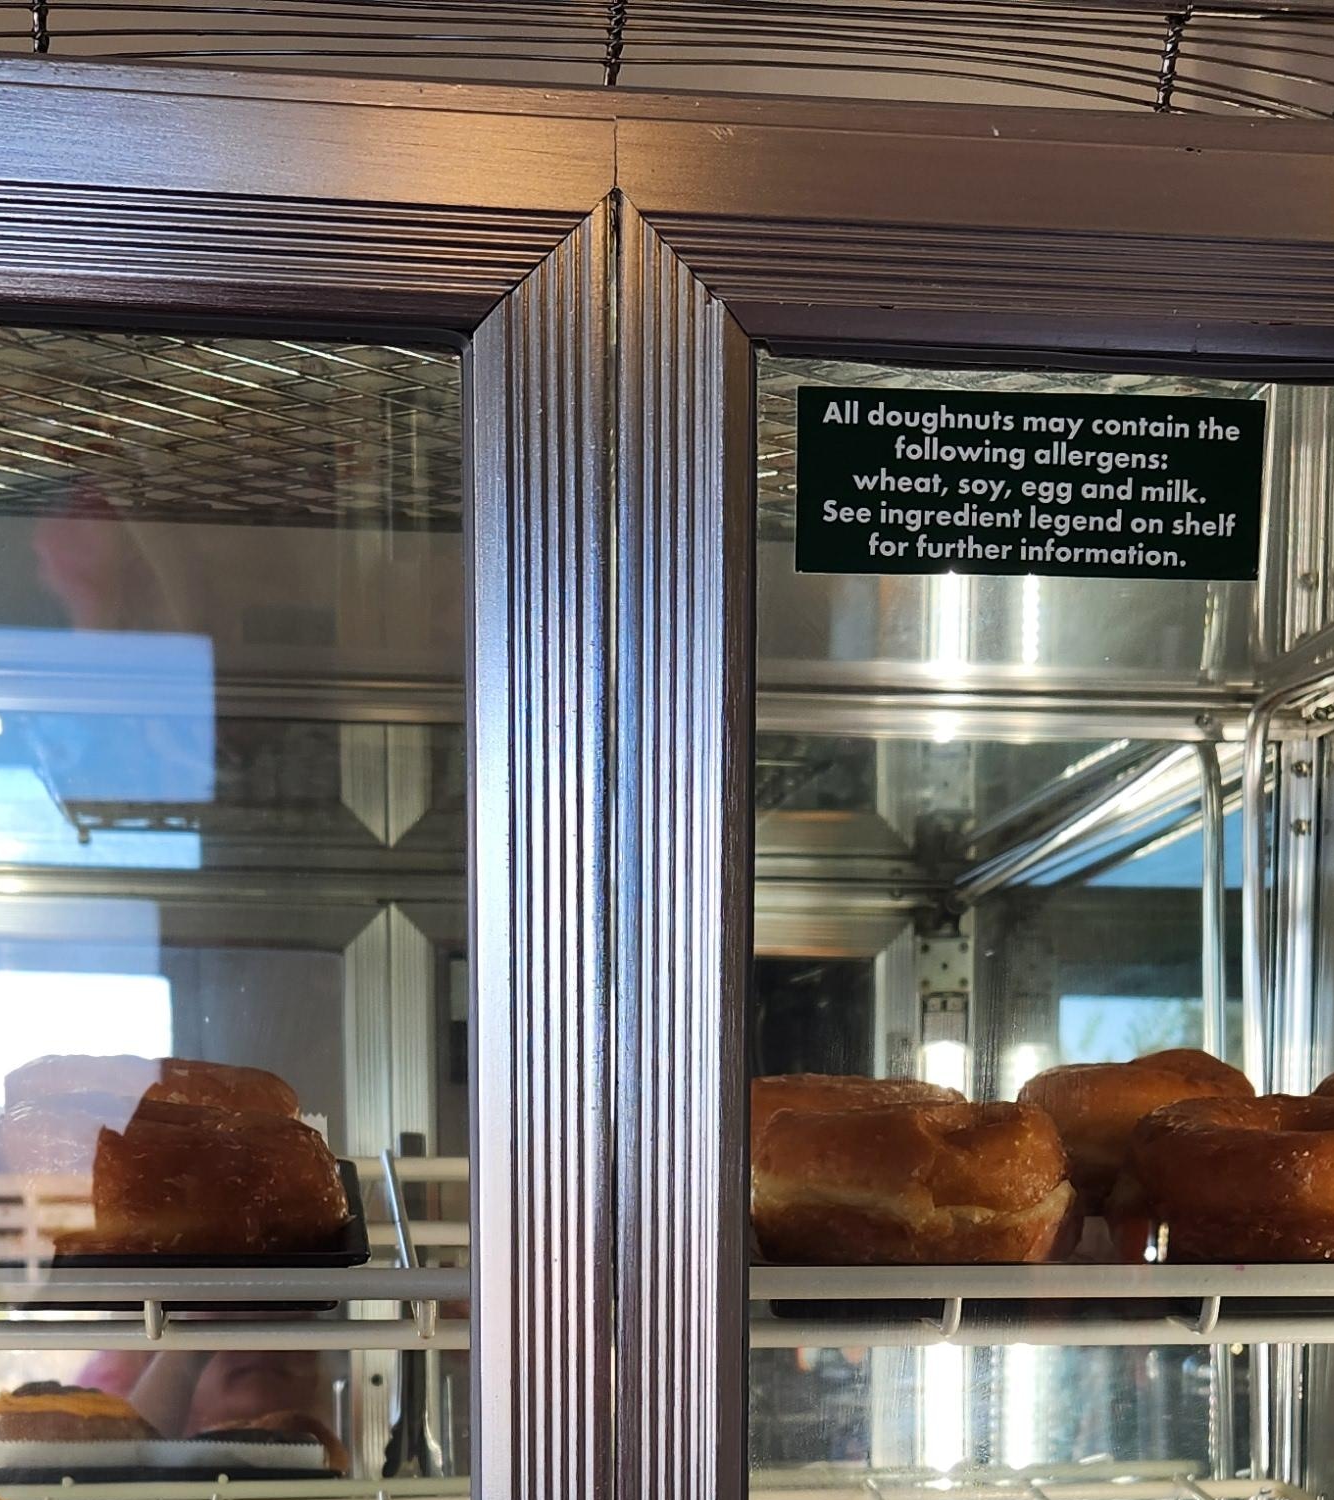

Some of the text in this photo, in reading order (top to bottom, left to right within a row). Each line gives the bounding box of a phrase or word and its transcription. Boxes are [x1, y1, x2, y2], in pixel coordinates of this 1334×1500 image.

[822, 399, 1241, 442] All doughnuts may contain the
[894, 434, 1169, 474] following allergens:
[852, 467, 1207, 505] wheat, soy, egg and milk.
[822, 499, 1237, 537] See ingredient legend on shelf
[868, 531, 1187, 568] for further information.
